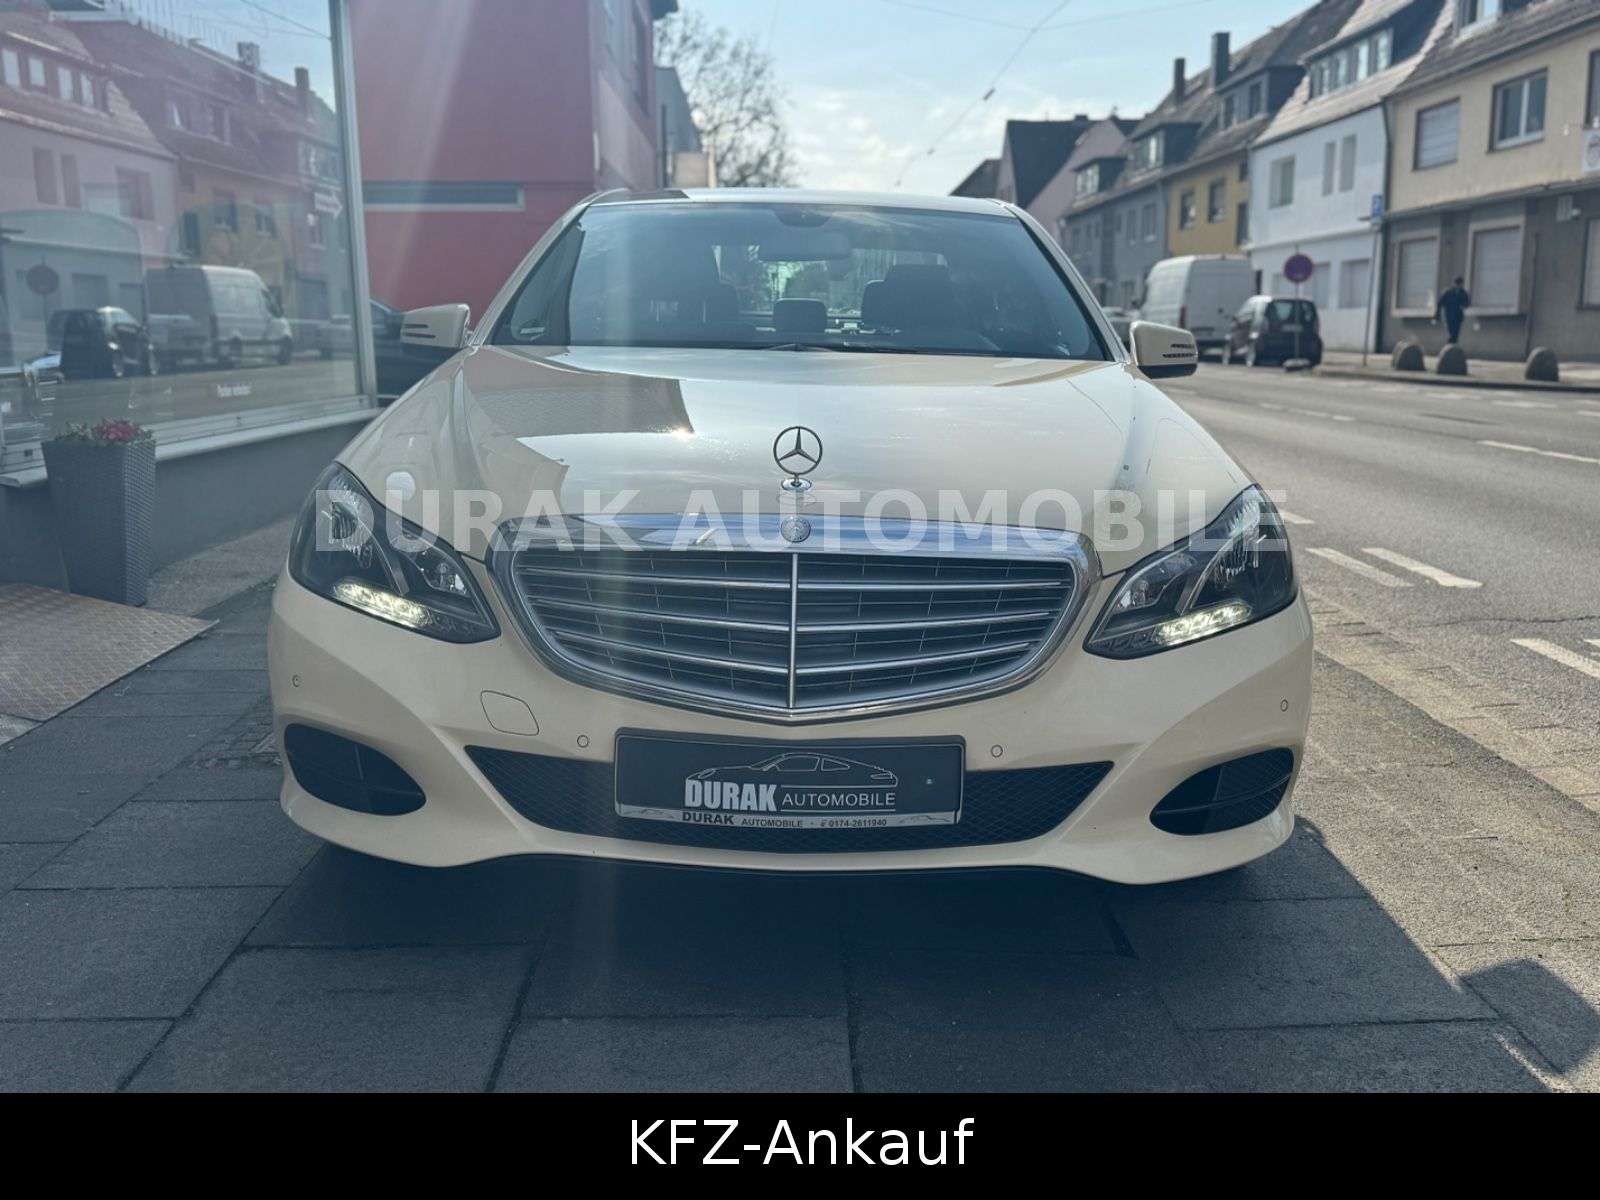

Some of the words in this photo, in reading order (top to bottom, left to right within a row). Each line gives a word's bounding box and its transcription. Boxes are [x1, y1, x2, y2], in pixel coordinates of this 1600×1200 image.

[684, 779, 778, 812] DURAK
[781, 792, 896, 807] AUTOMOBILE
[682, 811, 735, 825] DURAK
[741, 818, 804, 828] AUTOMOBILE
